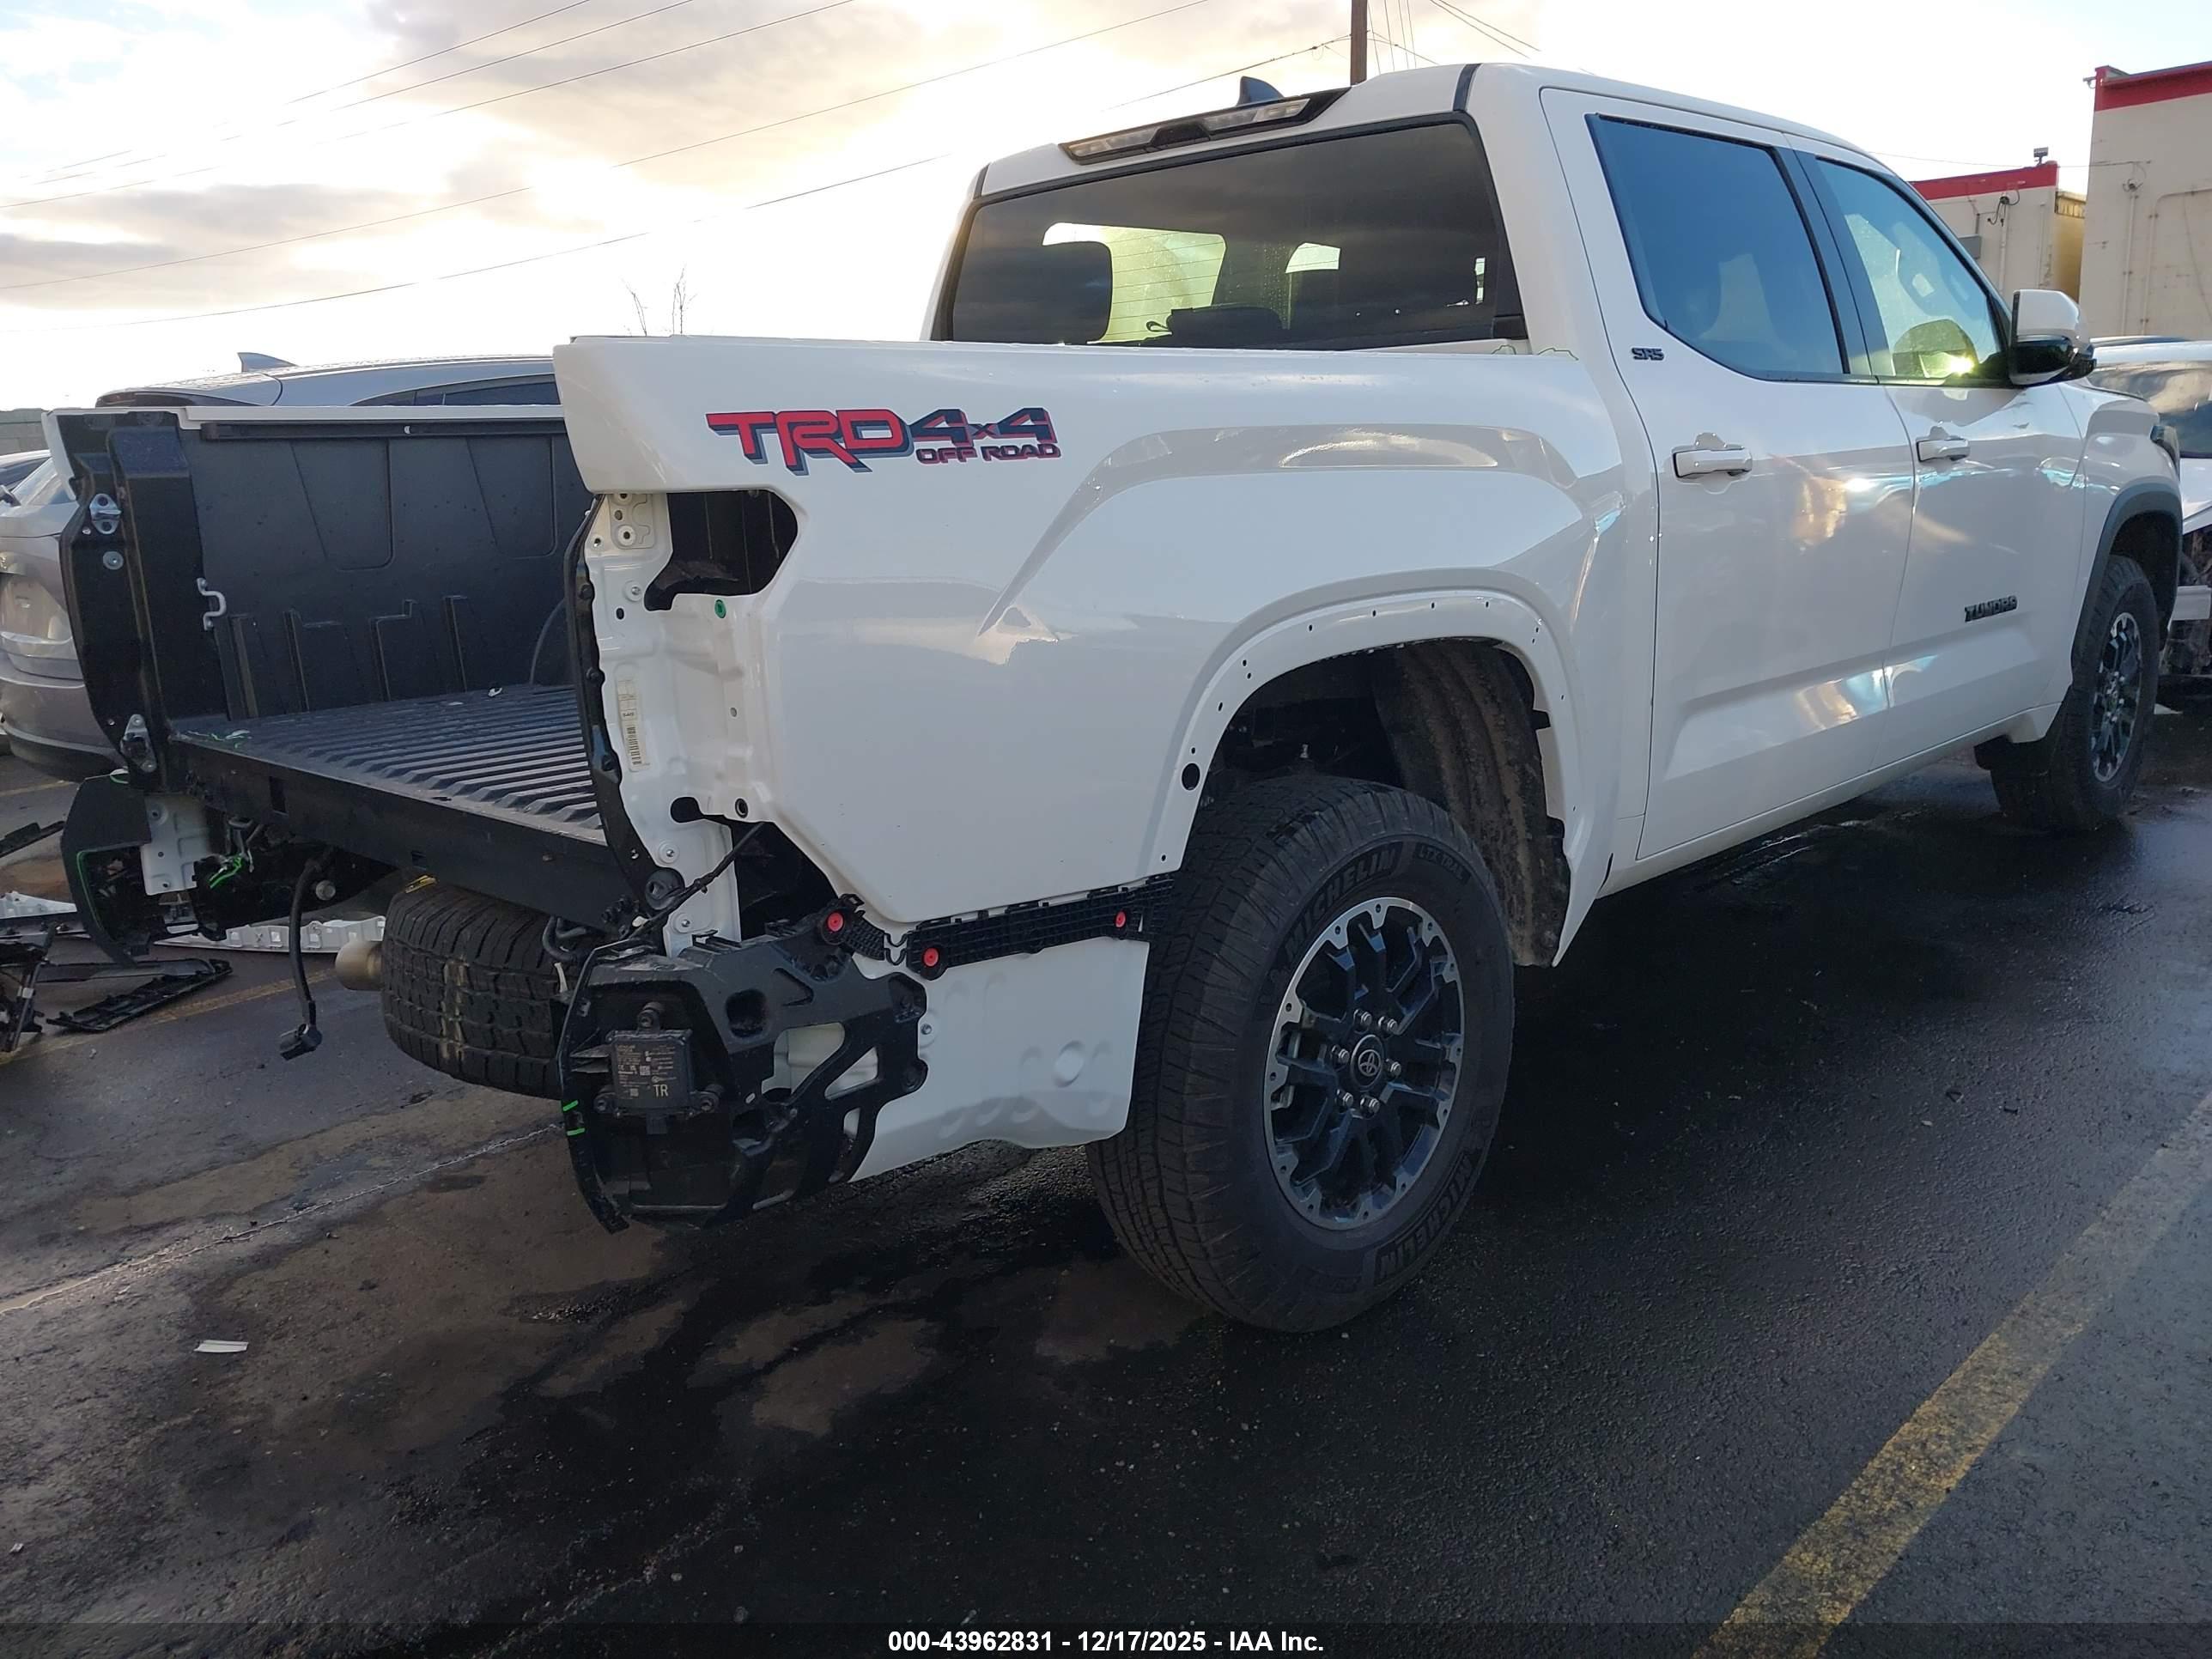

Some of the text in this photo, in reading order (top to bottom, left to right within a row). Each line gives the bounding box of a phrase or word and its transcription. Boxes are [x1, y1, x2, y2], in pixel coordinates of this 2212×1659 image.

[1632, 348, 1664, 361] SR5
[706, 408, 1058, 476] TRD 4x4
[915, 442, 1062, 465] OFF ROAD
[1964, 595, 2018, 623] TUNDRA
[1285, 845, 1396, 962] MICHELIN
[653, 1084, 669, 1097] TR
